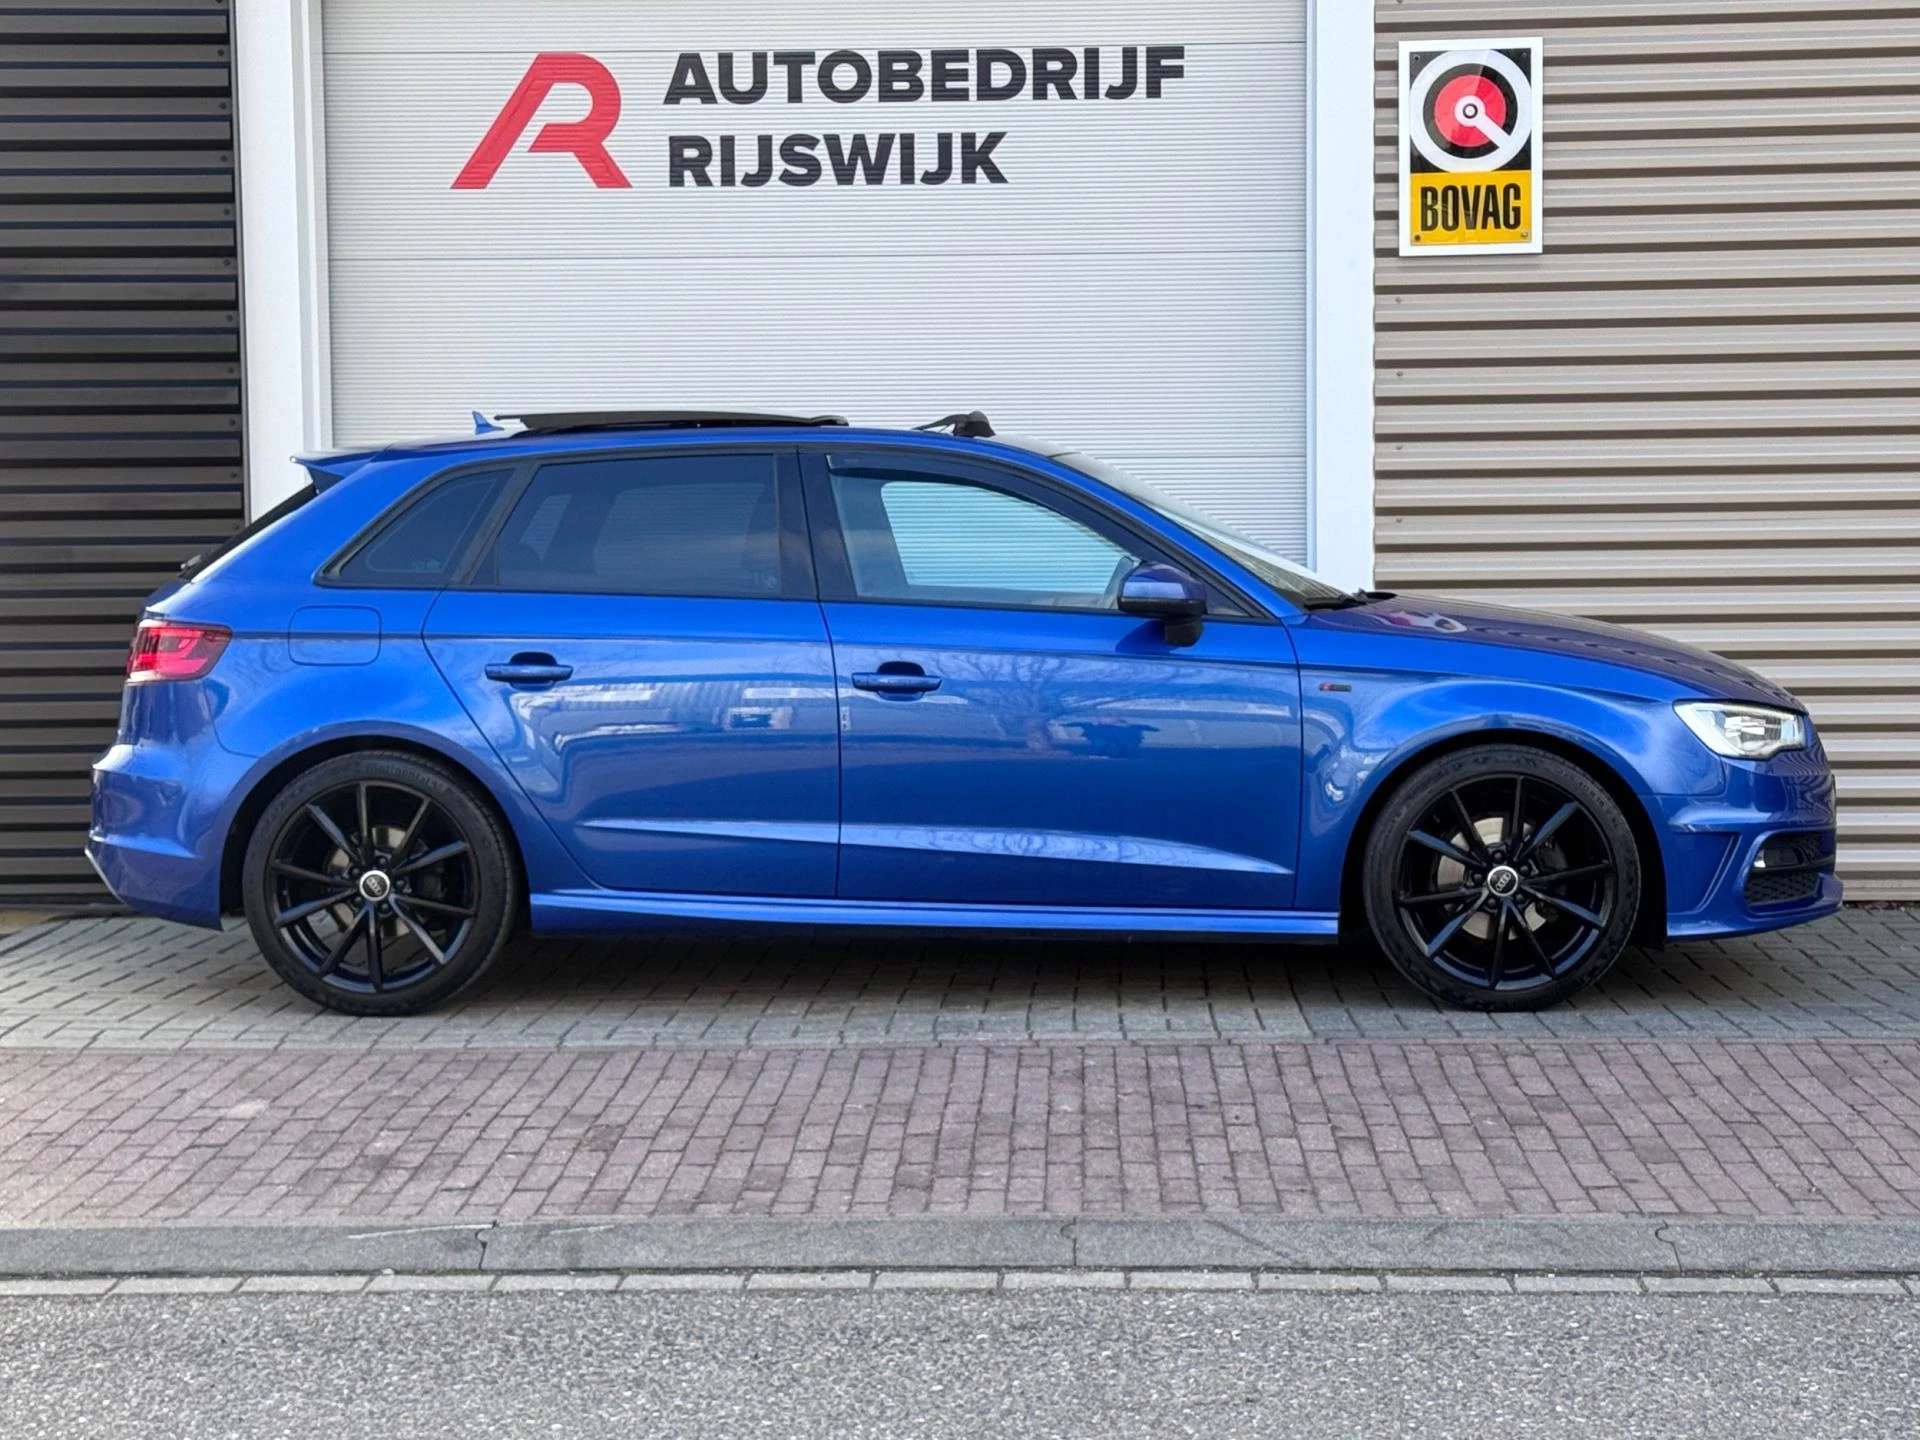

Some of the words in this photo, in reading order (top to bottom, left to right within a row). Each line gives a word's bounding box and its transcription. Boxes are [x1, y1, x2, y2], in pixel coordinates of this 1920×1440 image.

[663, 46, 1185, 105] AUTOBEDRIJF
[668, 131, 1009, 188] RIJSWIJK
[1420, 183, 1521, 232] BOVAG
